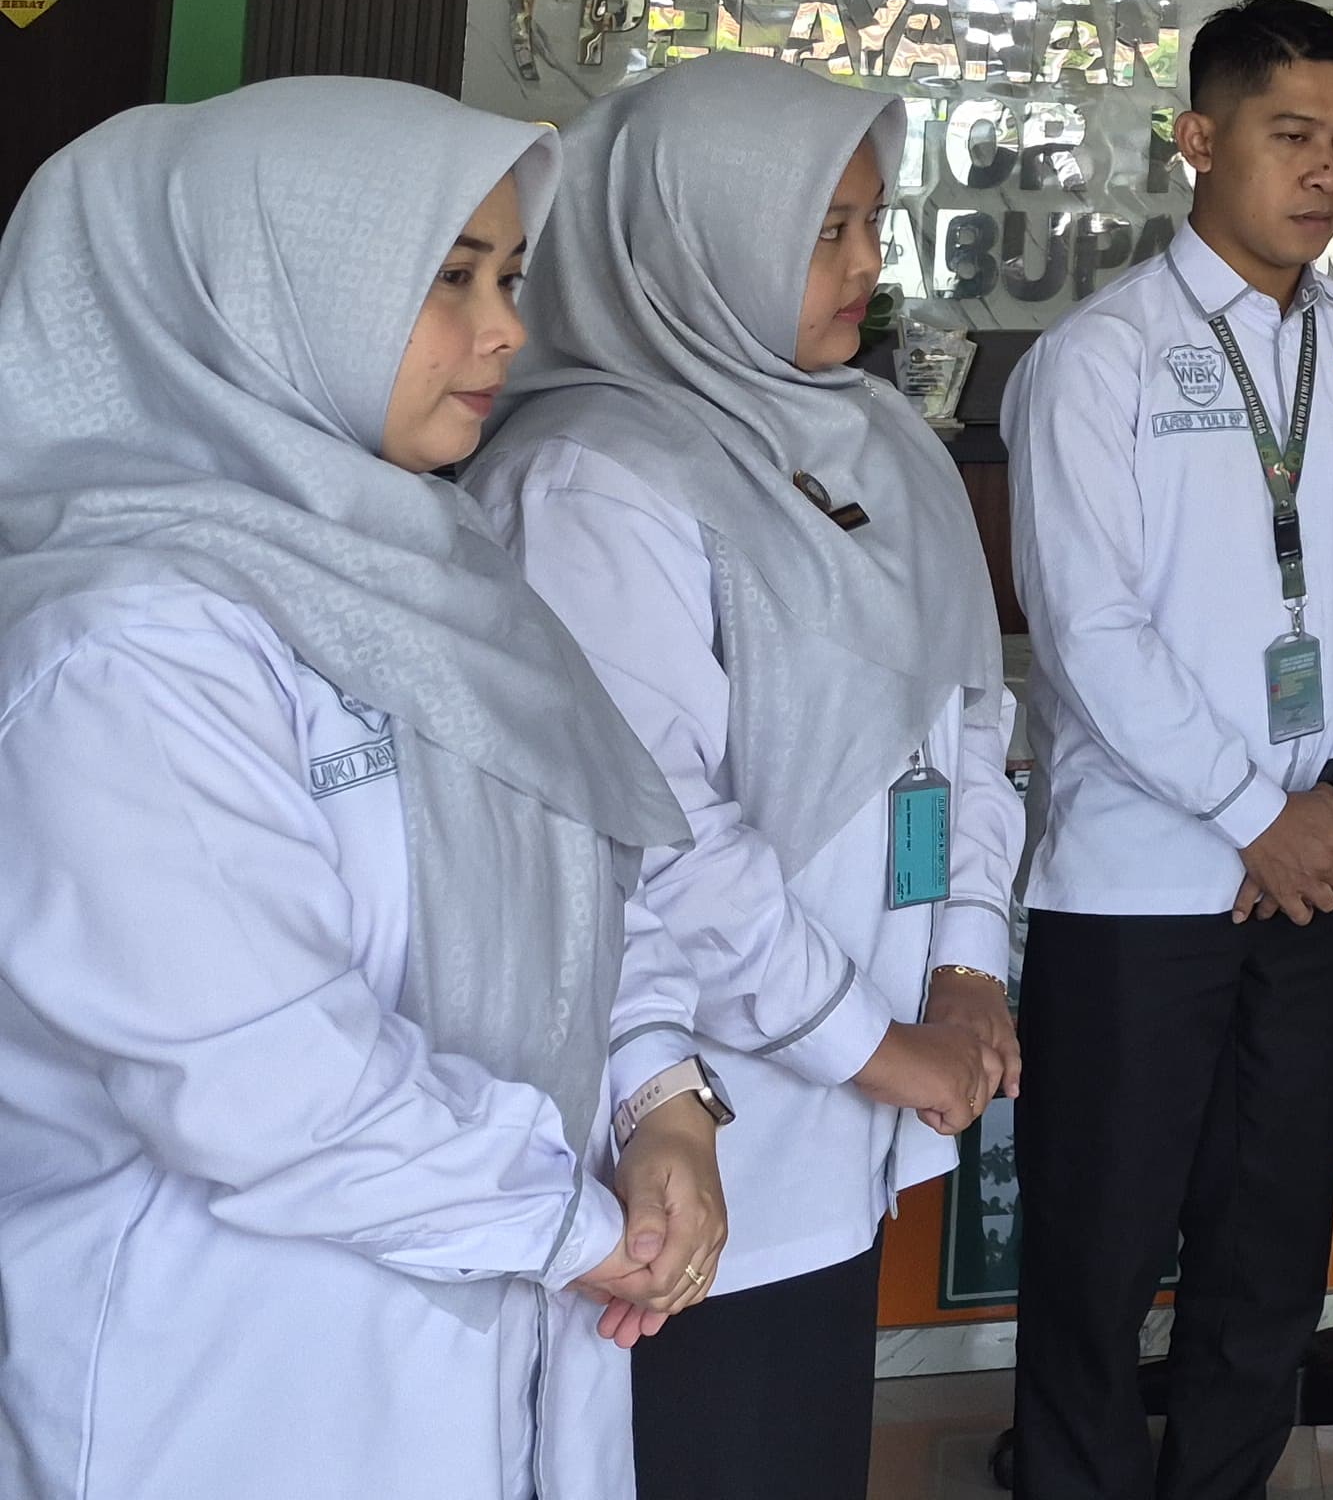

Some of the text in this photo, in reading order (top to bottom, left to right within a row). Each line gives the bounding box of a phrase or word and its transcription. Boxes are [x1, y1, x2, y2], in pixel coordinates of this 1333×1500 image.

[899, 98, 1088, 193] TOR
[1175, 364, 1220, 384] WBK
[1197, 412, 1226, 427] YULI
[310, 758, 357, 790] UKI
